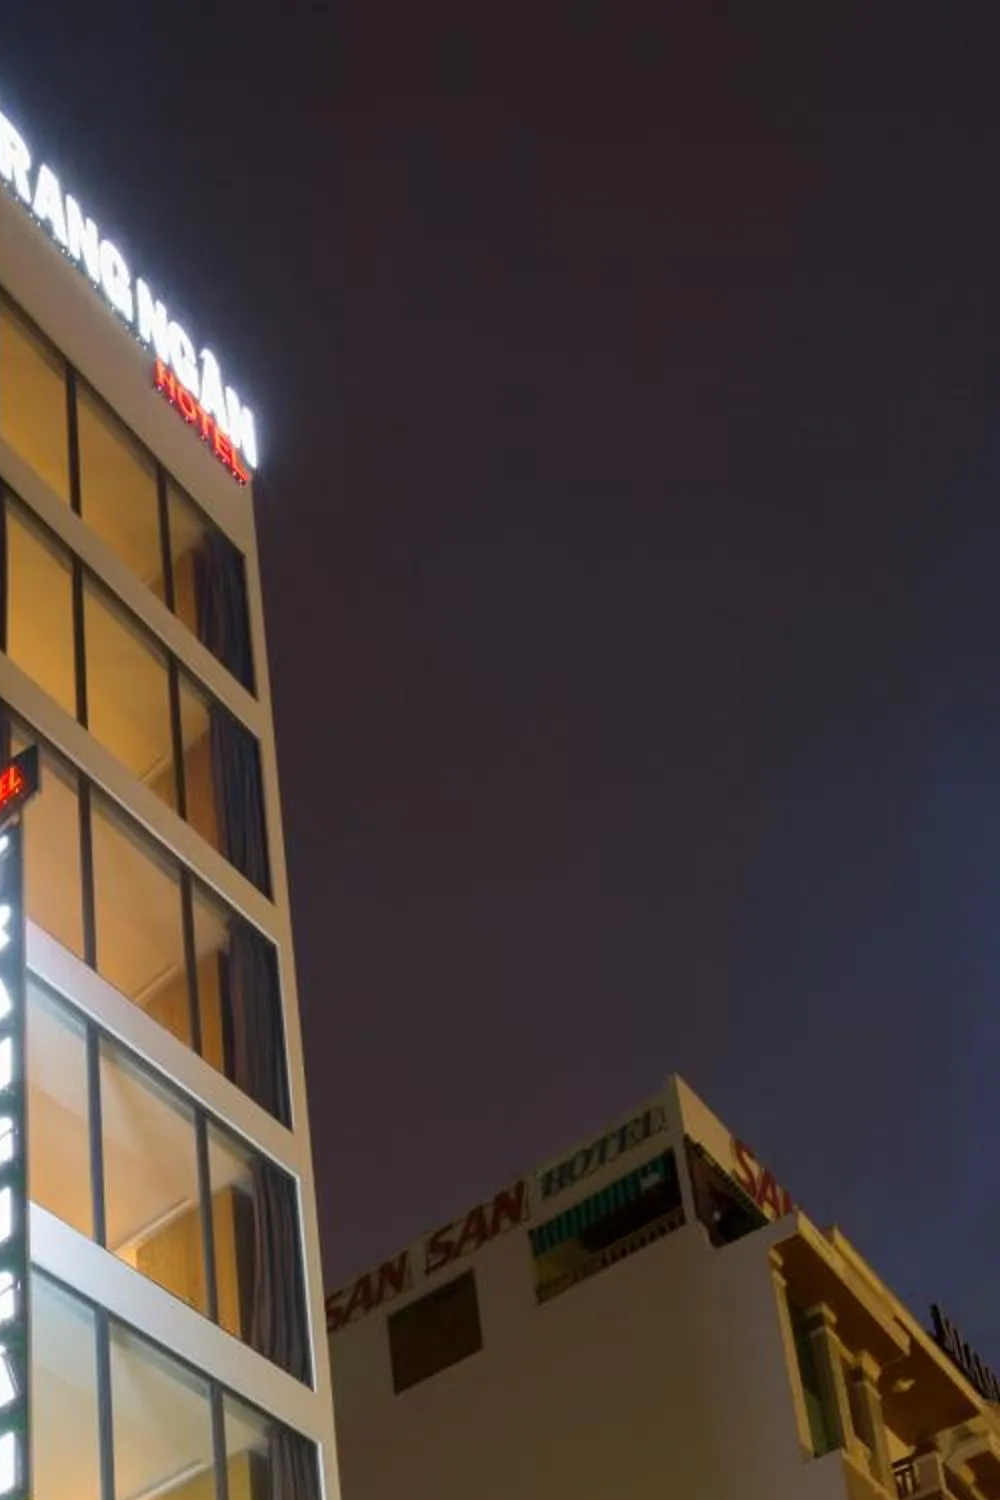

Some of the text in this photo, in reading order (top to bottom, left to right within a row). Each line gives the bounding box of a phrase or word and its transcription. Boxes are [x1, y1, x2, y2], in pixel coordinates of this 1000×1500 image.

[154, 354, 249, 487] HOTEL
[325, 1106, 668, 1333] SAN SAN HOTEL
